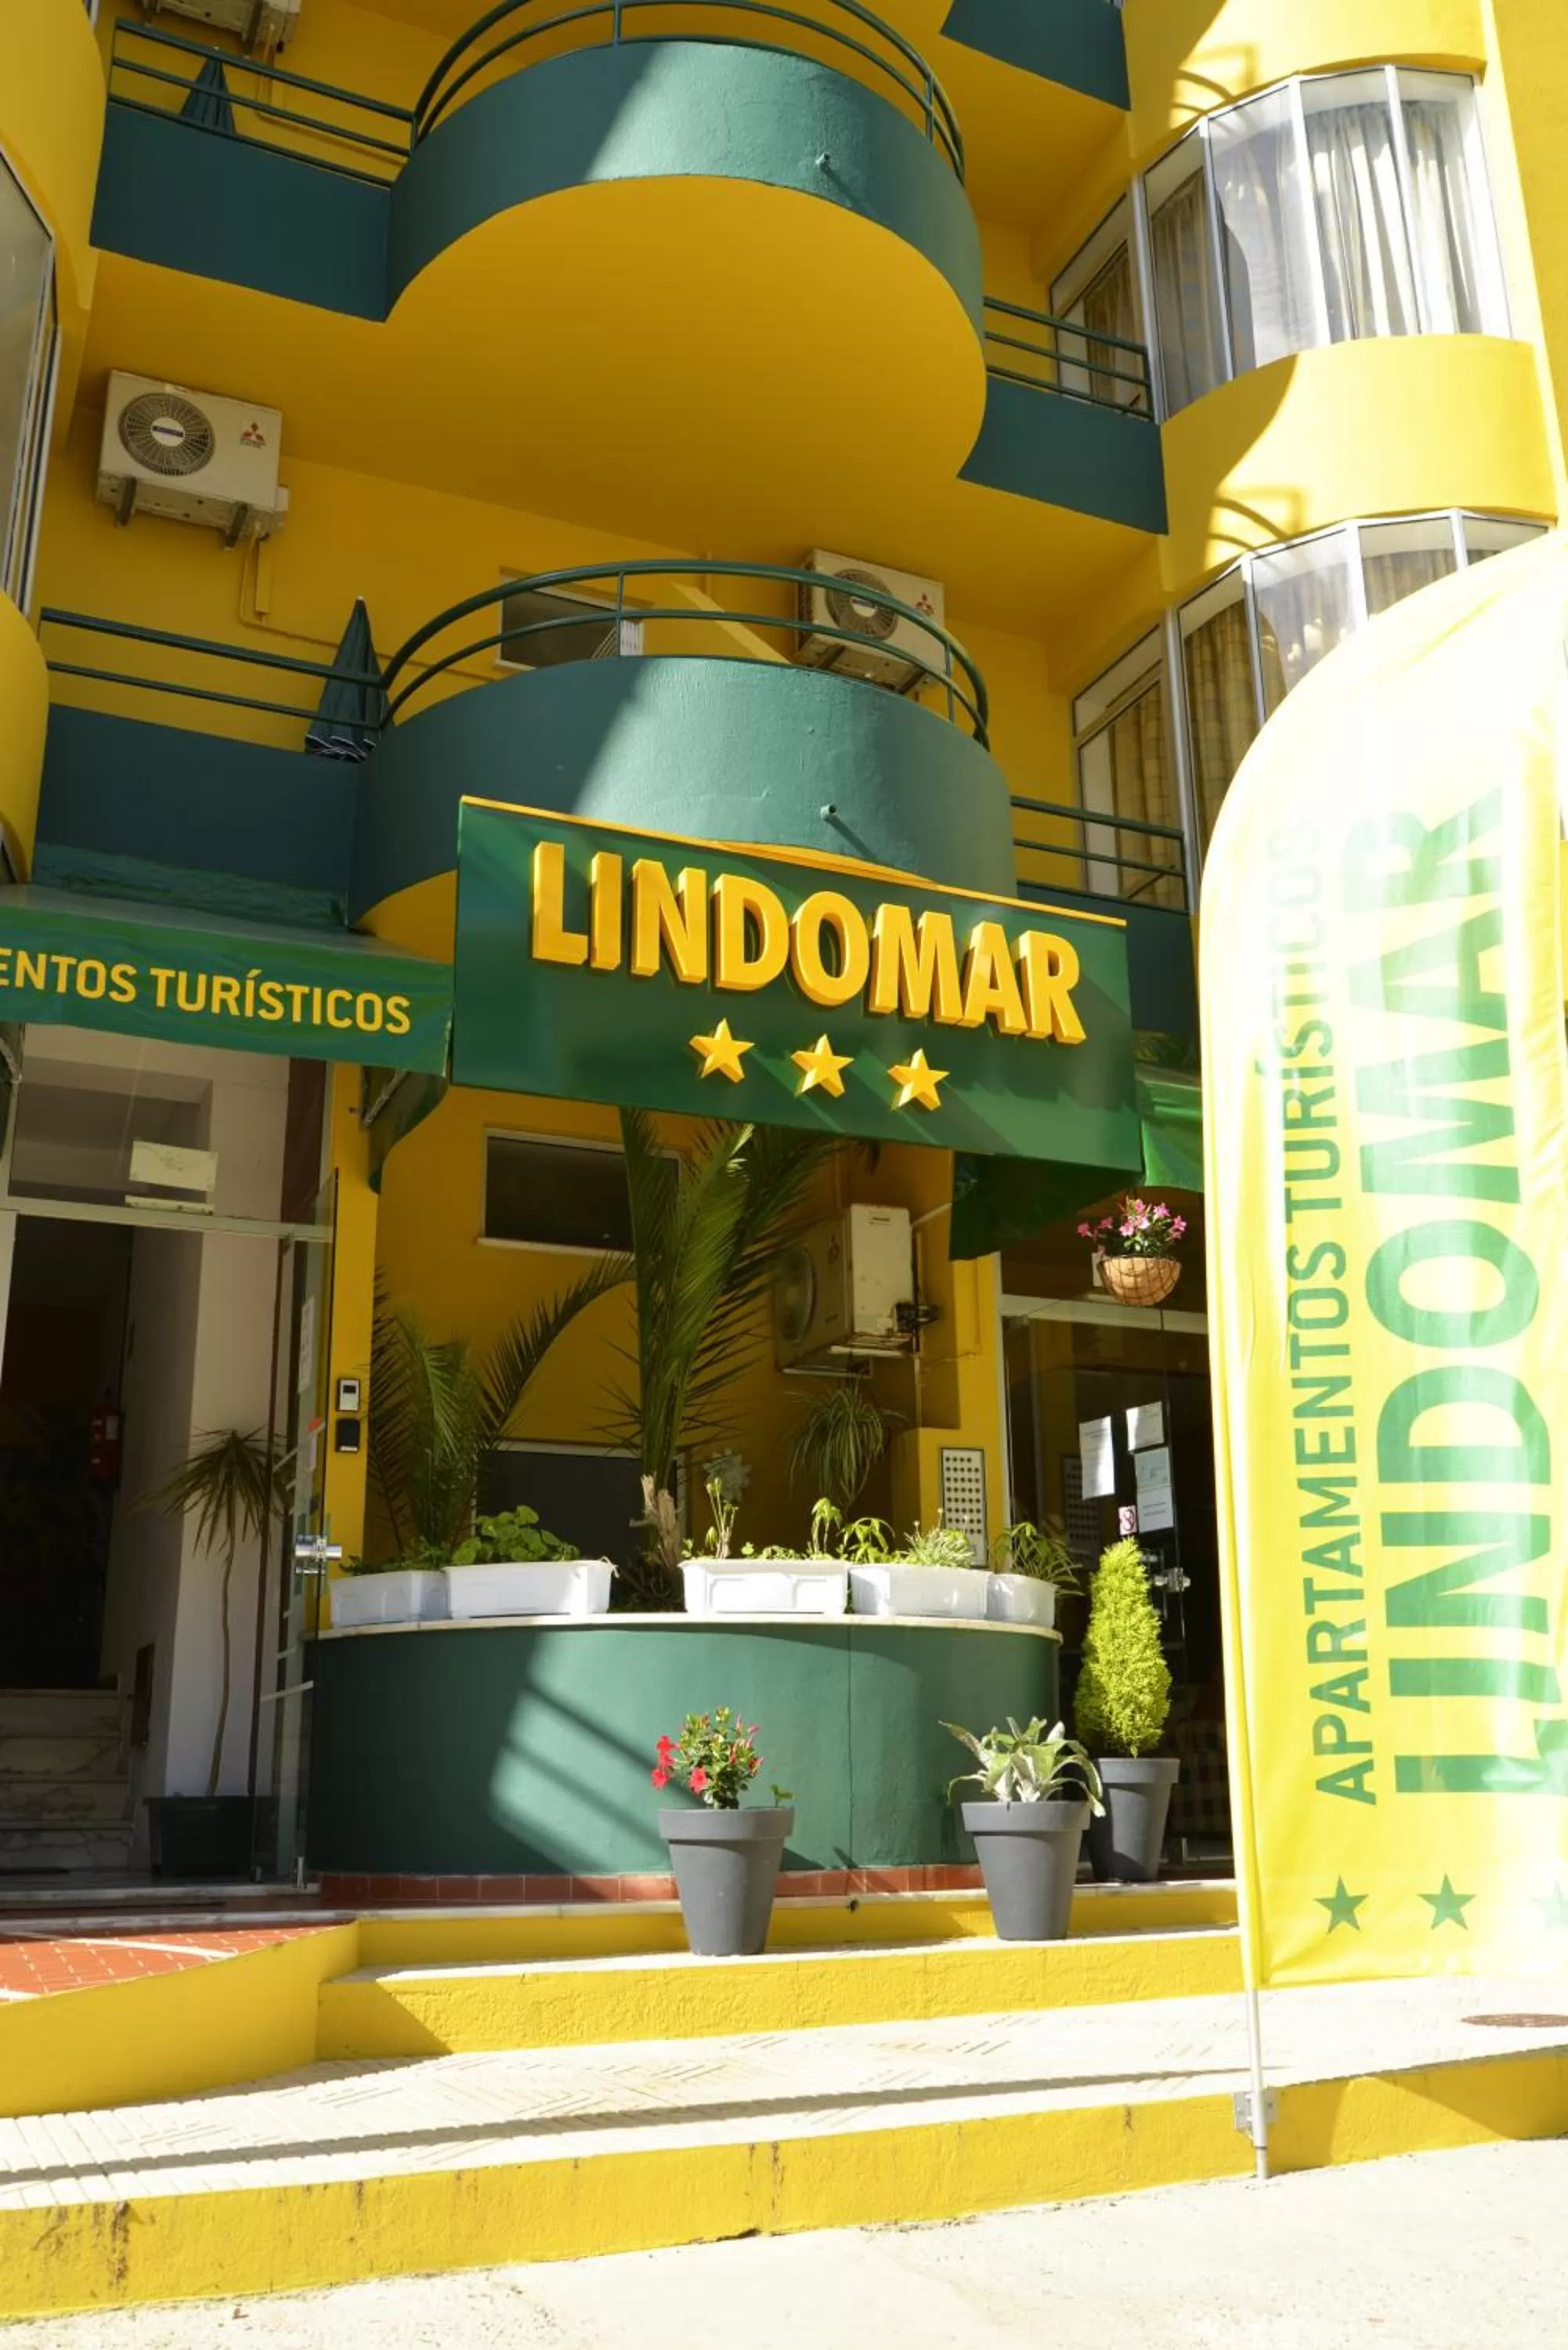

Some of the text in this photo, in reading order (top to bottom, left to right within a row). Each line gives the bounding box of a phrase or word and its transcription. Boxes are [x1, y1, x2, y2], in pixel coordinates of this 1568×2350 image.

[150, 968, 411, 1035] TURÍSTICOS
[532, 841, 1087, 1045] LINDOMAR
[1253, 822, 1378, 1806] APARTAMENTOS TURÍSTICOS
[1341, 785, 1568, 1795] LINDOMAR
